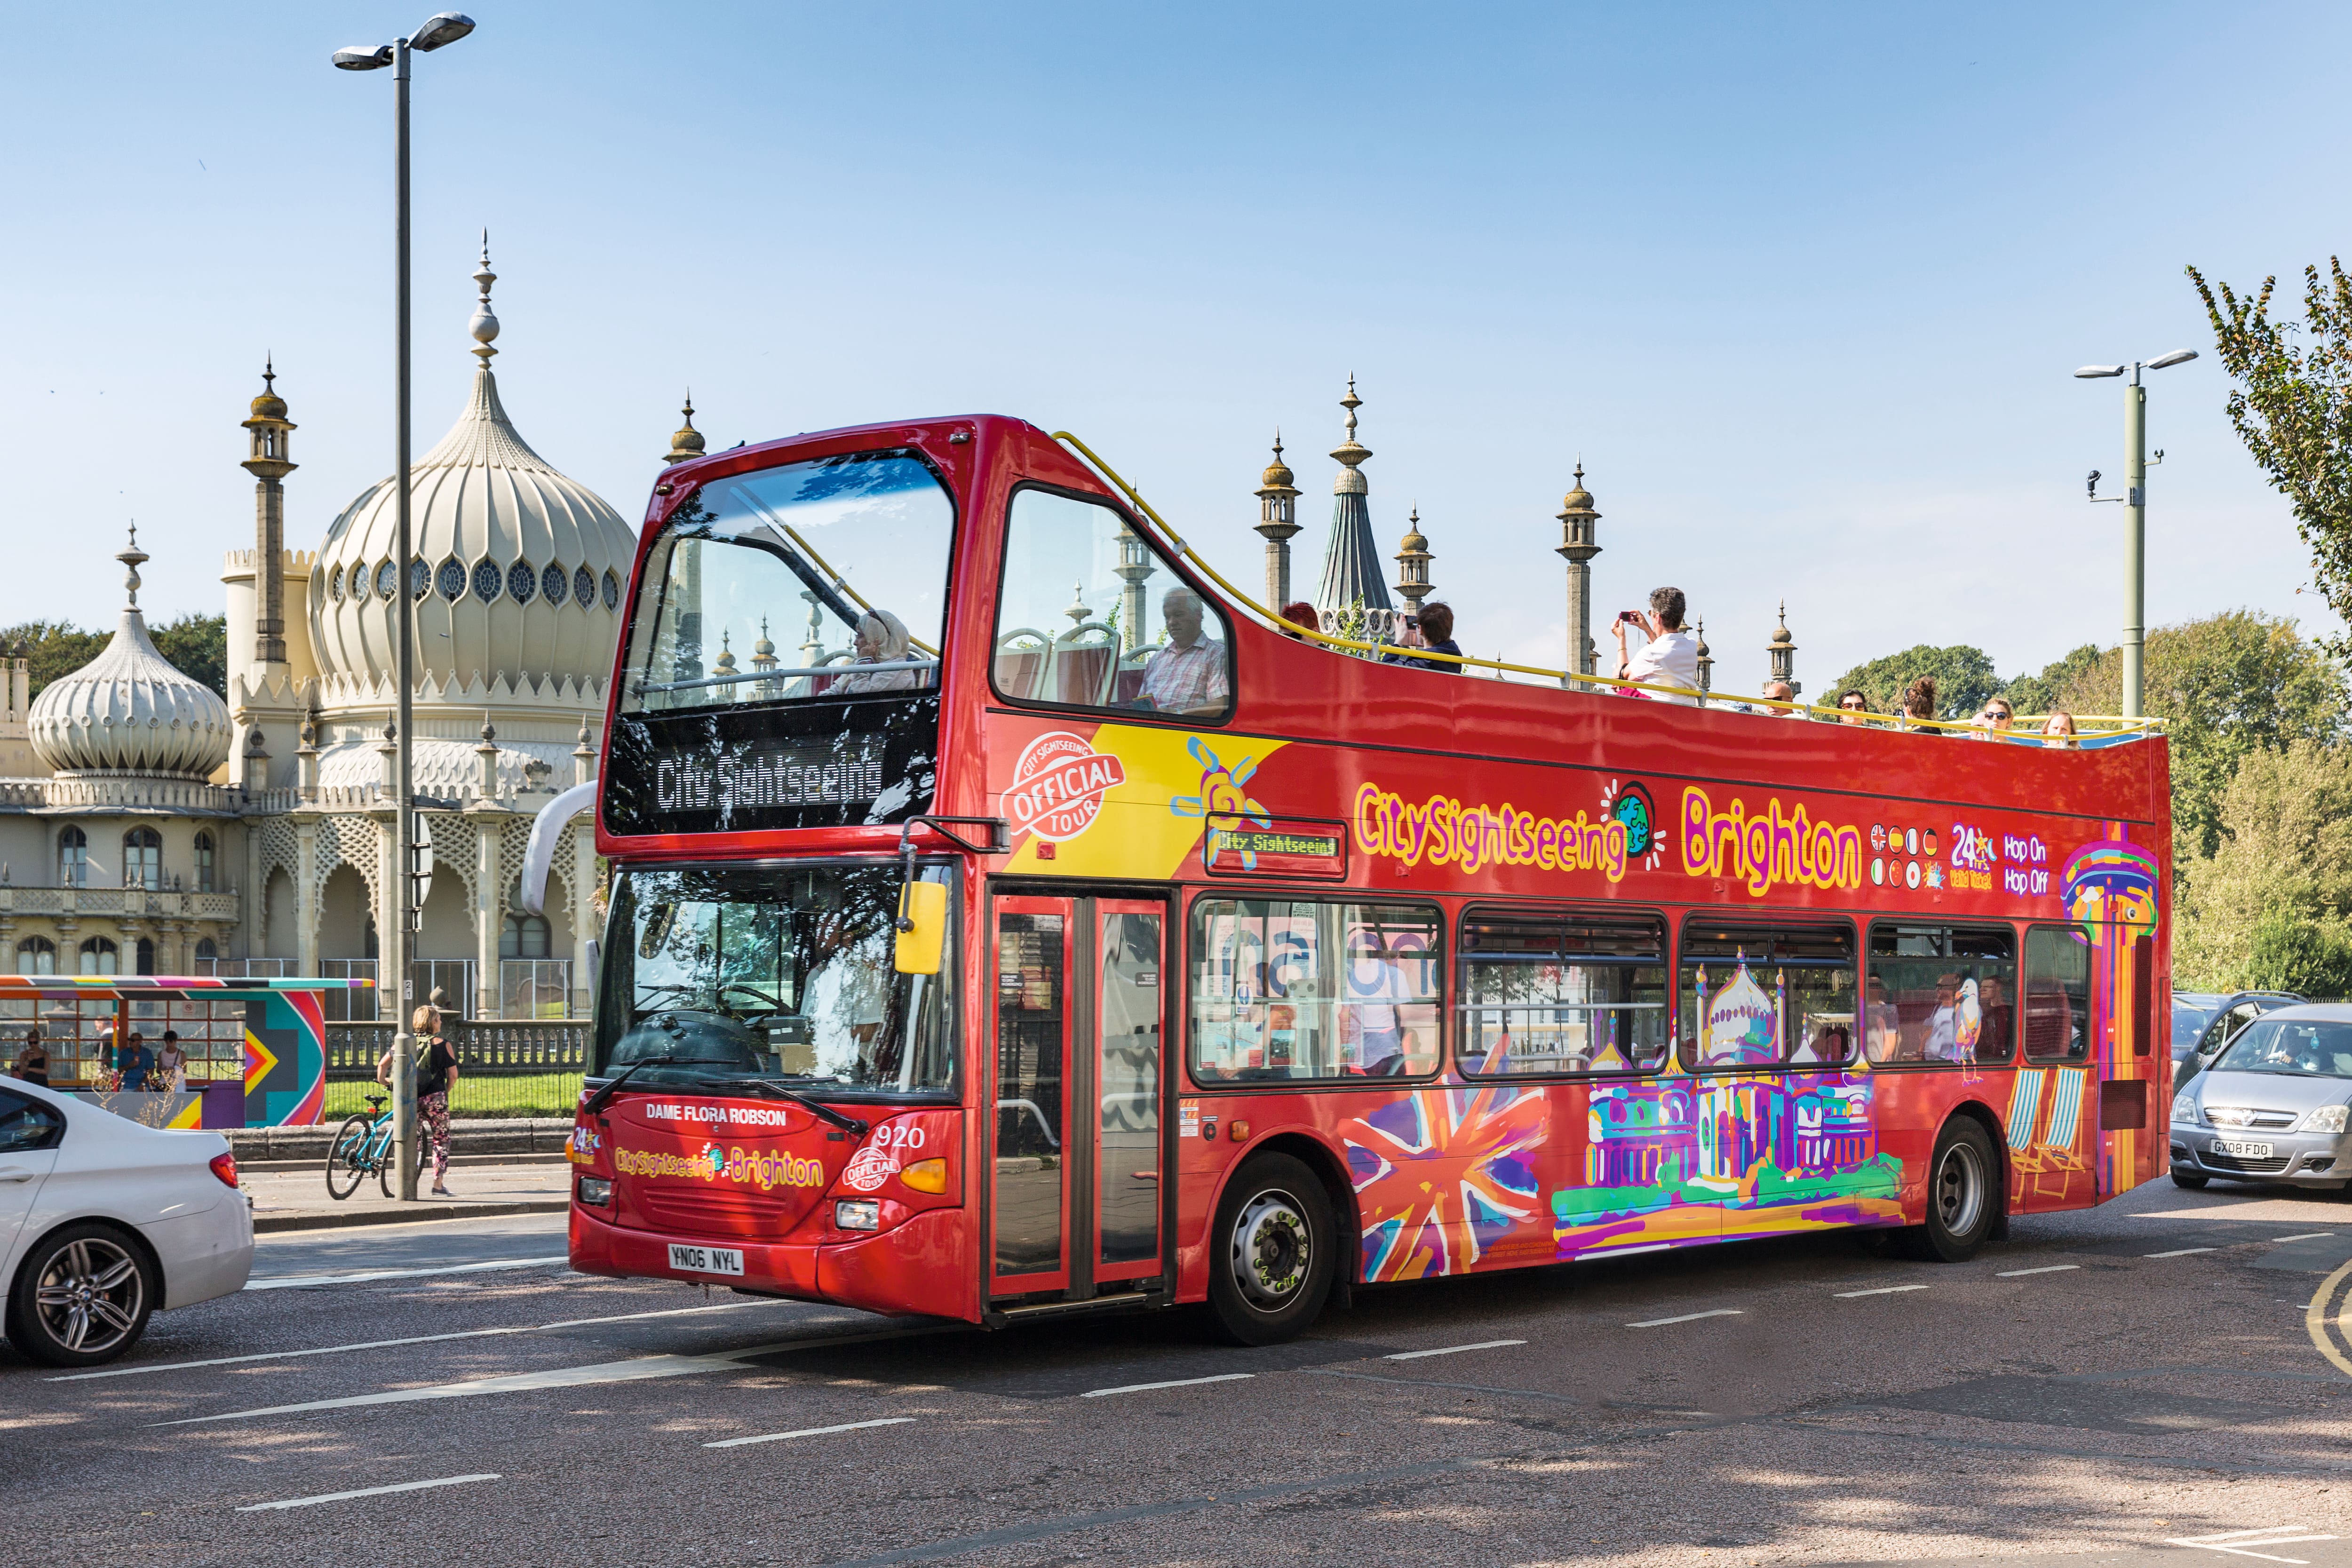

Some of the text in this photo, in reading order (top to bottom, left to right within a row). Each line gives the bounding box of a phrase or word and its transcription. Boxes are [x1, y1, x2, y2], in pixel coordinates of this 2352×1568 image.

[1023, 740, 1089, 776] CITY SIGHTSEEING
[658, 751, 882, 808] City Sightseeing
[1013, 759, 1119, 821] OFFICIAL
[1050, 799, 1097, 832] TOUR
[1218, 831, 1336, 854] City Sightseeing
[1681, 786, 1862, 897] Brighton
[1951, 823, 1976, 868] 24
[2004, 835, 2046, 863] Hop On
[1950, 869, 1992, 890] Valid Ticket
[2004, 868, 2049, 896] Hop Off
[646, 1103, 787, 1126] DAME FLORA ROBSON
[574, 1127, 587, 1151] 24
[877, 1125, 925, 1148] 920
[2215, 1141, 2267, 1155] GX08 FDO
[730, 1146, 824, 1191] Brighton
[848, 1161, 897, 1180] OFFICIAL
[860, 1176, 884, 1187] TOUR
[672, 1247, 740, 1272] YN06 NYL
